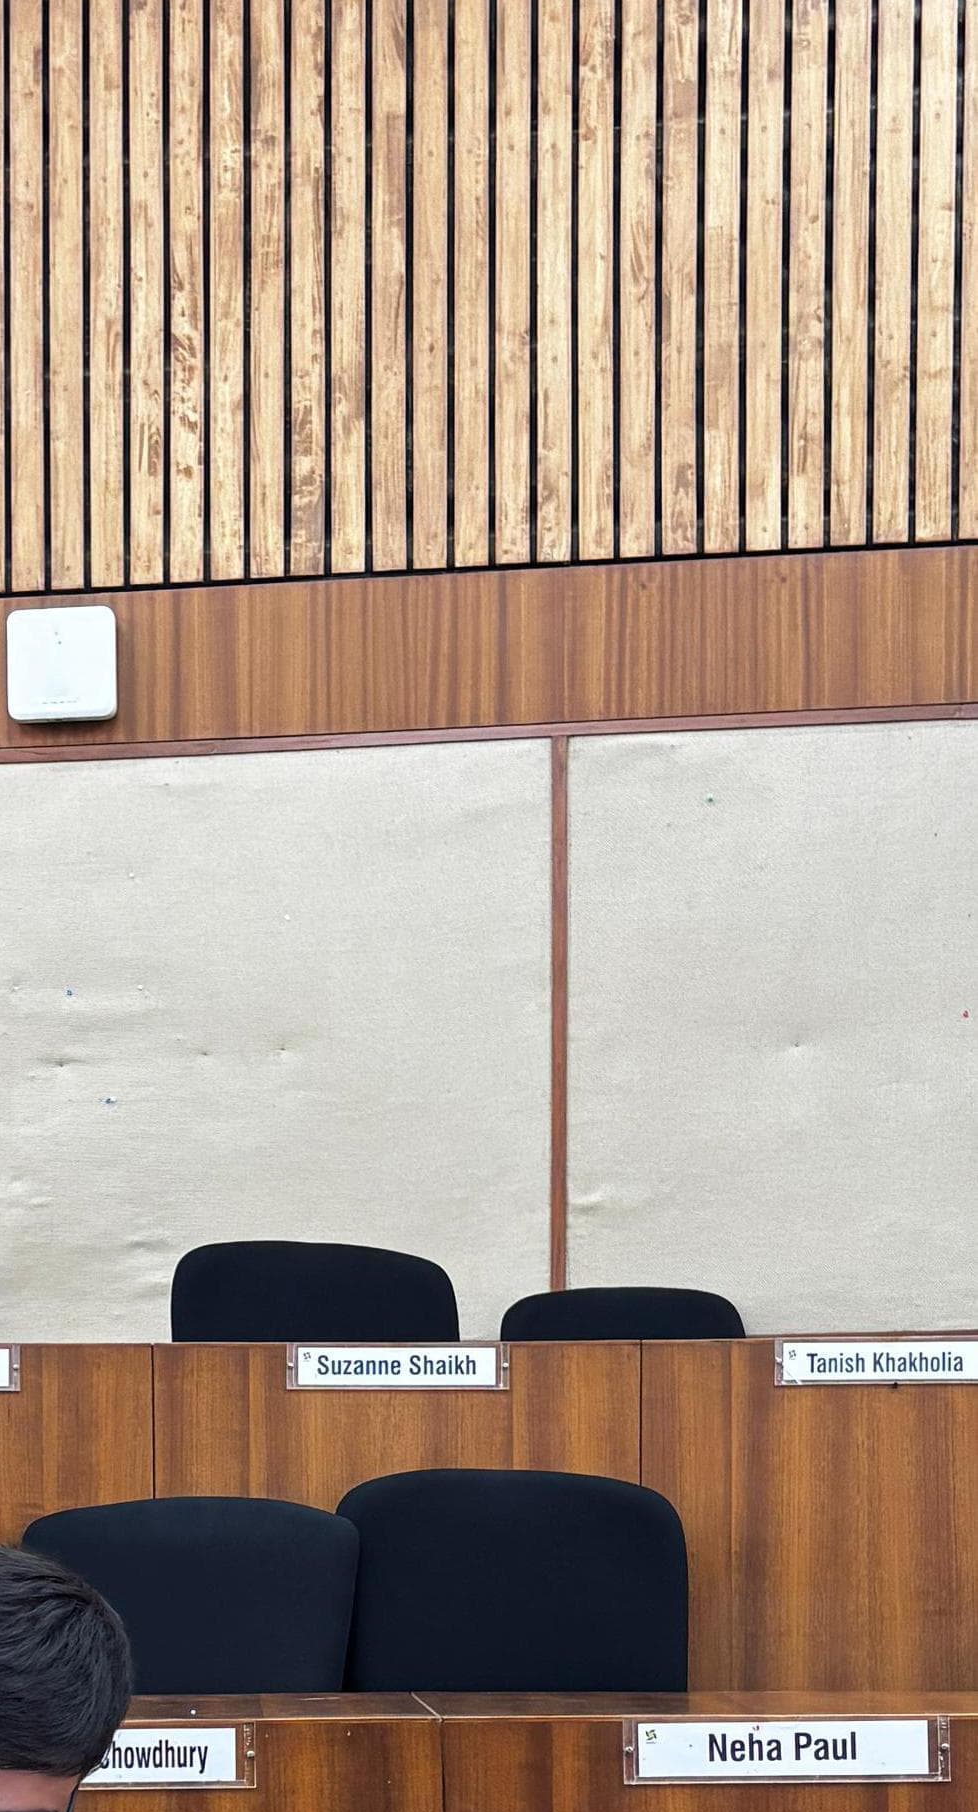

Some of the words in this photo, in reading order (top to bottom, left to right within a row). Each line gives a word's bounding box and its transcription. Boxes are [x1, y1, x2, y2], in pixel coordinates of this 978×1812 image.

[317, 1355, 401, 1376] Suzanne
[409, 1354, 476, 1376] Shaikh
[806, 1352, 865, 1373] Tanish
[873, 1351, 963, 1373] Khakholia
[708, 1732, 782, 1762] Neha
[794, 1731, 857, 1761] Paul
